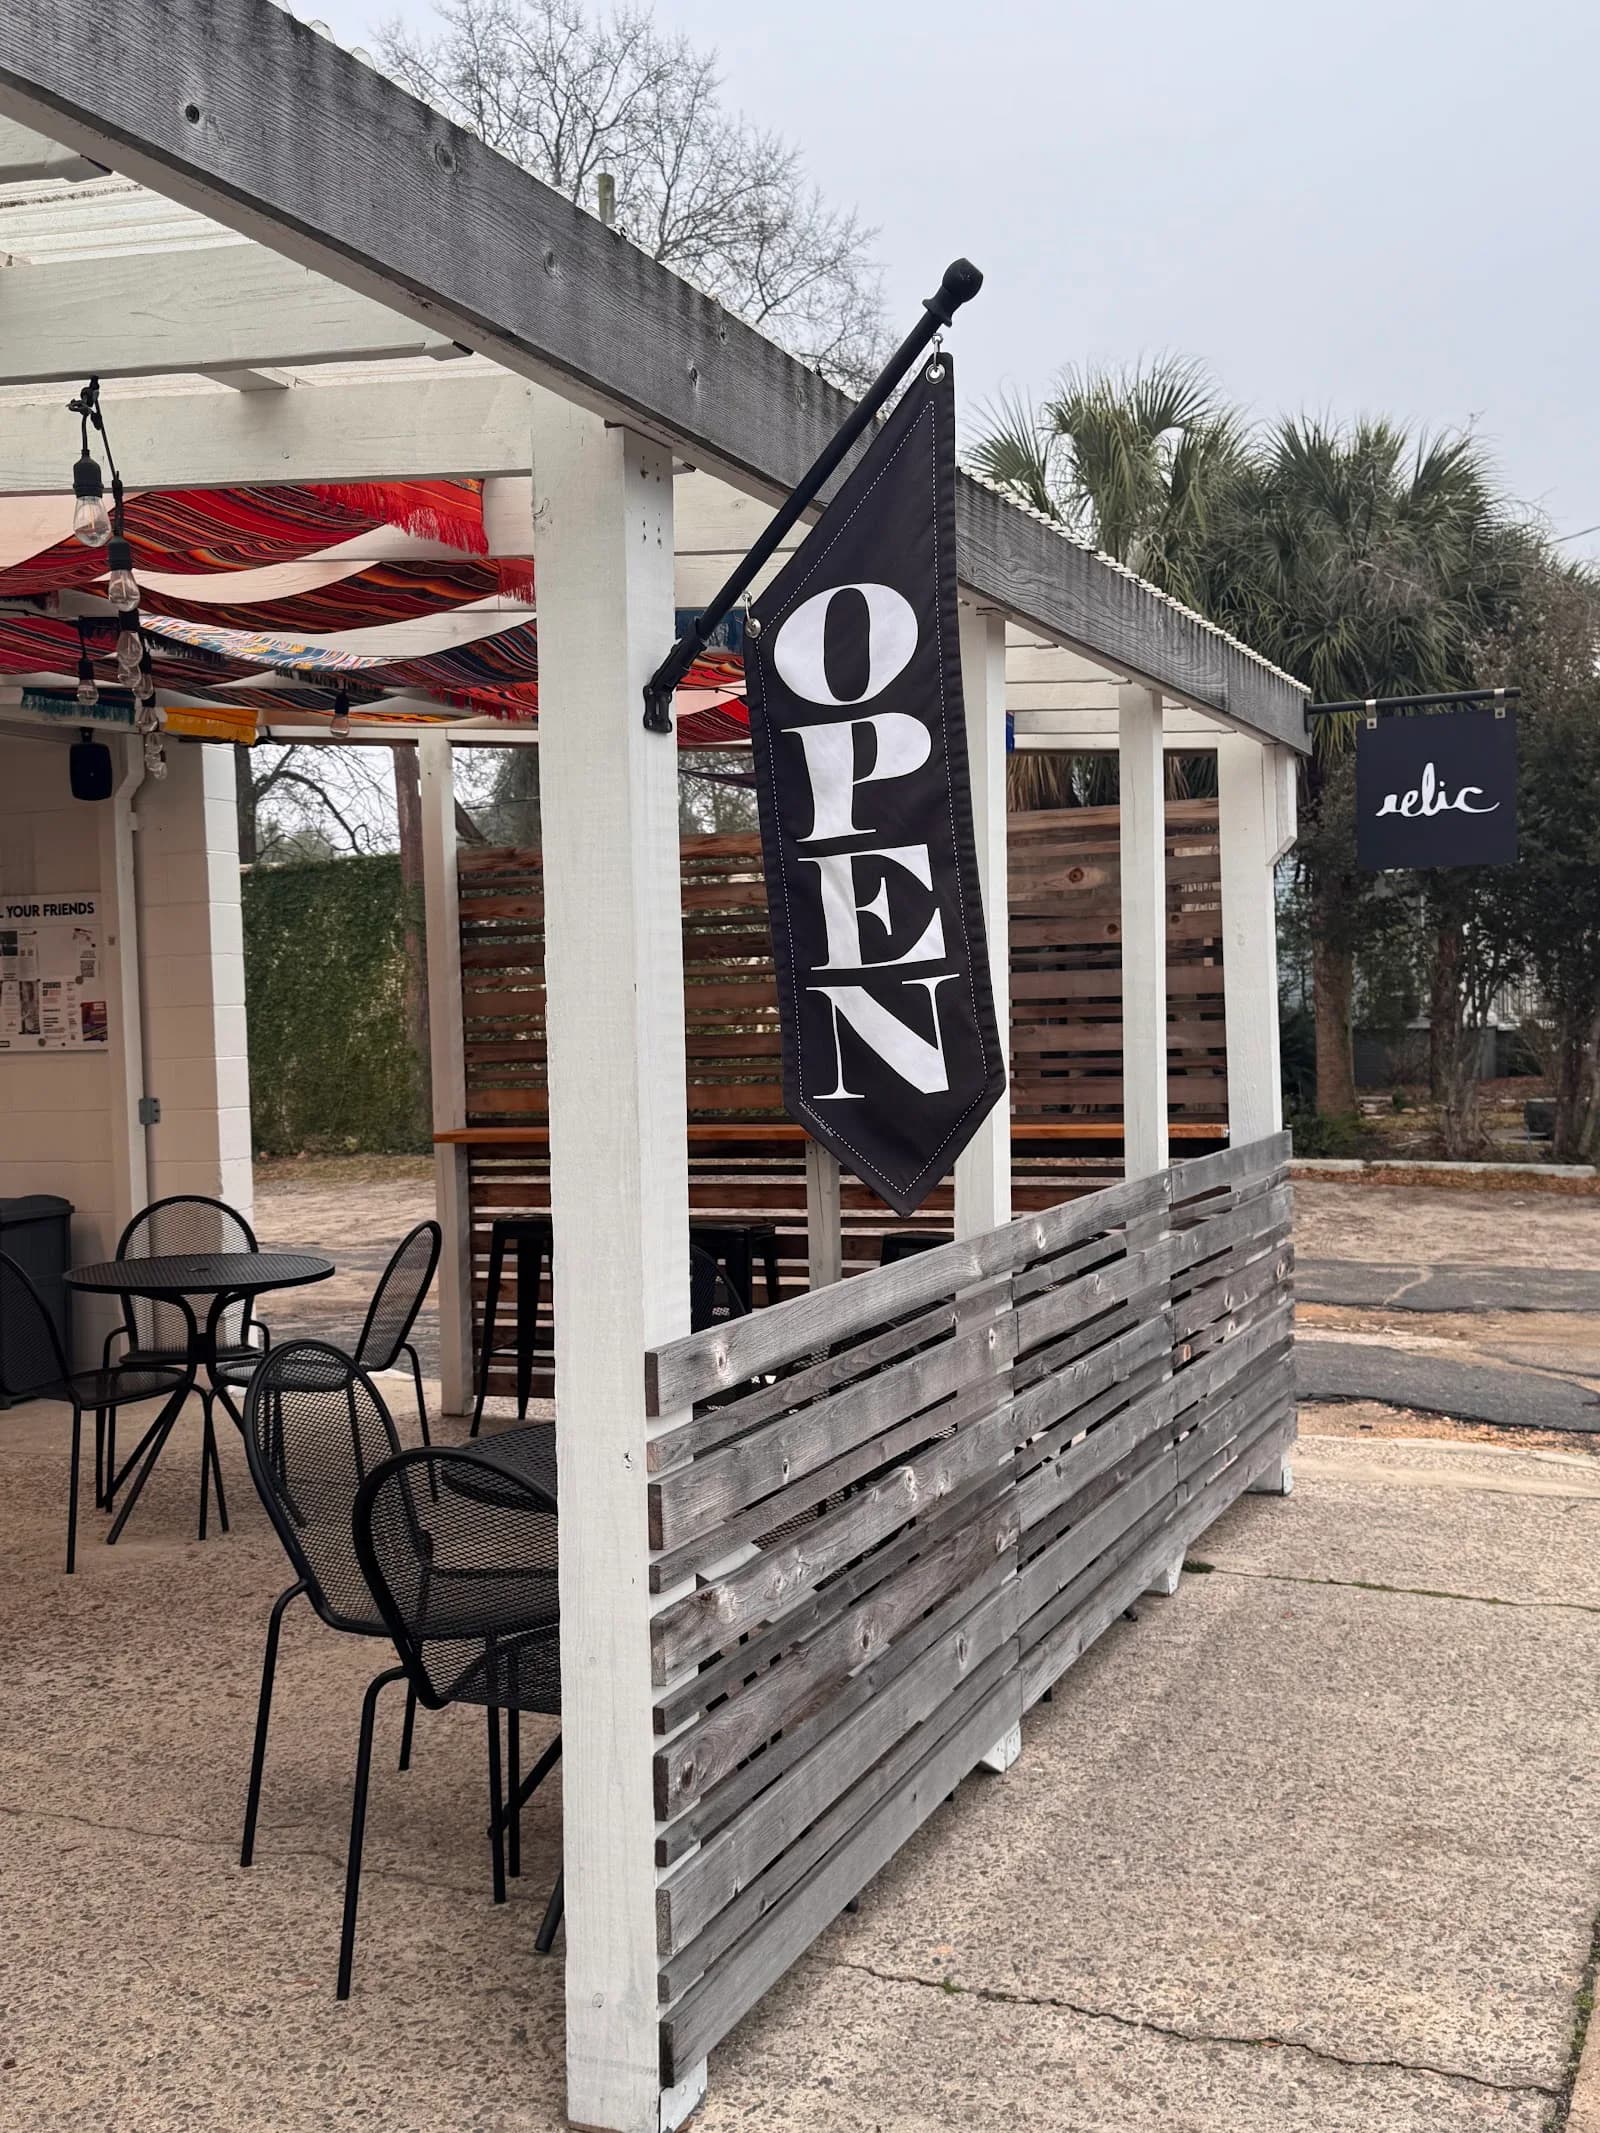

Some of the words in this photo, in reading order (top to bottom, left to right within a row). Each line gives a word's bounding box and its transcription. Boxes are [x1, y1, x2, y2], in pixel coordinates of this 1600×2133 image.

[1376, 762, 1500, 817] relic
[774, 583, 959, 1099] OPEN
[6, 904, 41, 918] YOUR
[43, 902, 95, 917] FRIENDS
